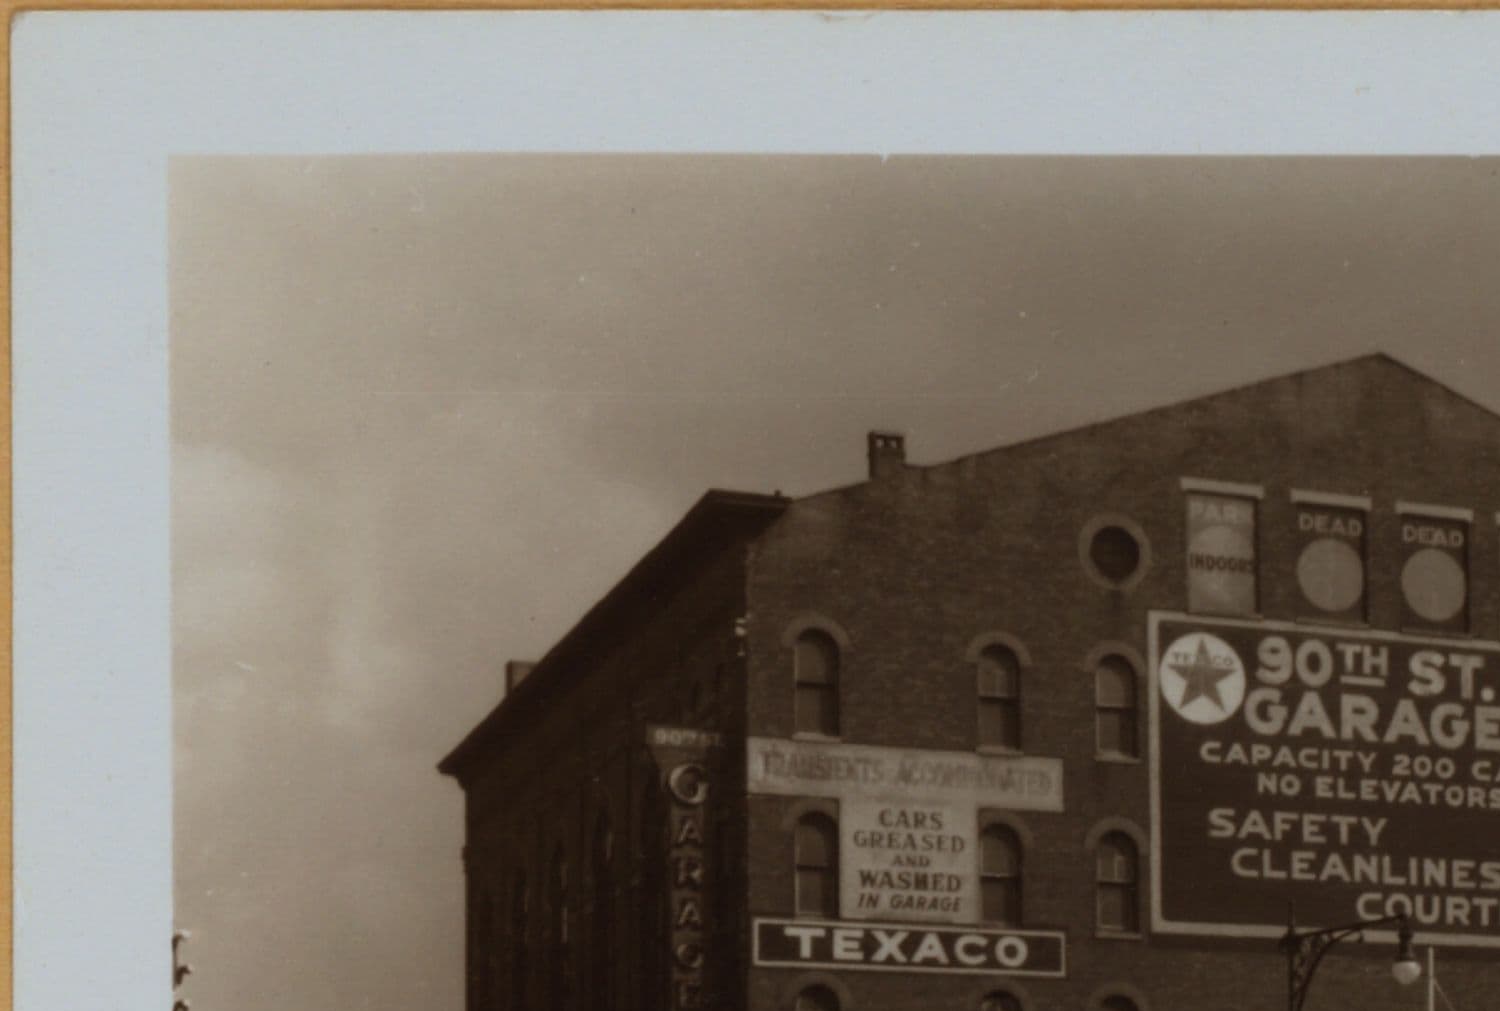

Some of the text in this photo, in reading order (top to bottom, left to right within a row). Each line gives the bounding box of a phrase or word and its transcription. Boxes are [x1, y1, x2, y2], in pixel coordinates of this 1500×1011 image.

[1299, 513, 1362, 538] DEAD
[1402, 525, 1464, 548] DEAD
[1407, 650, 1496, 702] ST.
[1200, 740, 1378, 774] CAPACITY
[1392, 753, 1456, 780] 200
[1257, 772, 1300, 797] NO
[877, 807, 944, 831] CARS
[1206, 807, 1388, 847] SAFETY
[852, 829, 966, 854] GREASED
[890, 854, 932, 868] AND
[857, 869, 962, 893] WASHED
[857, 892, 961, 913] IN GARAGE
[783, 926, 1030, 968] TEXACO
